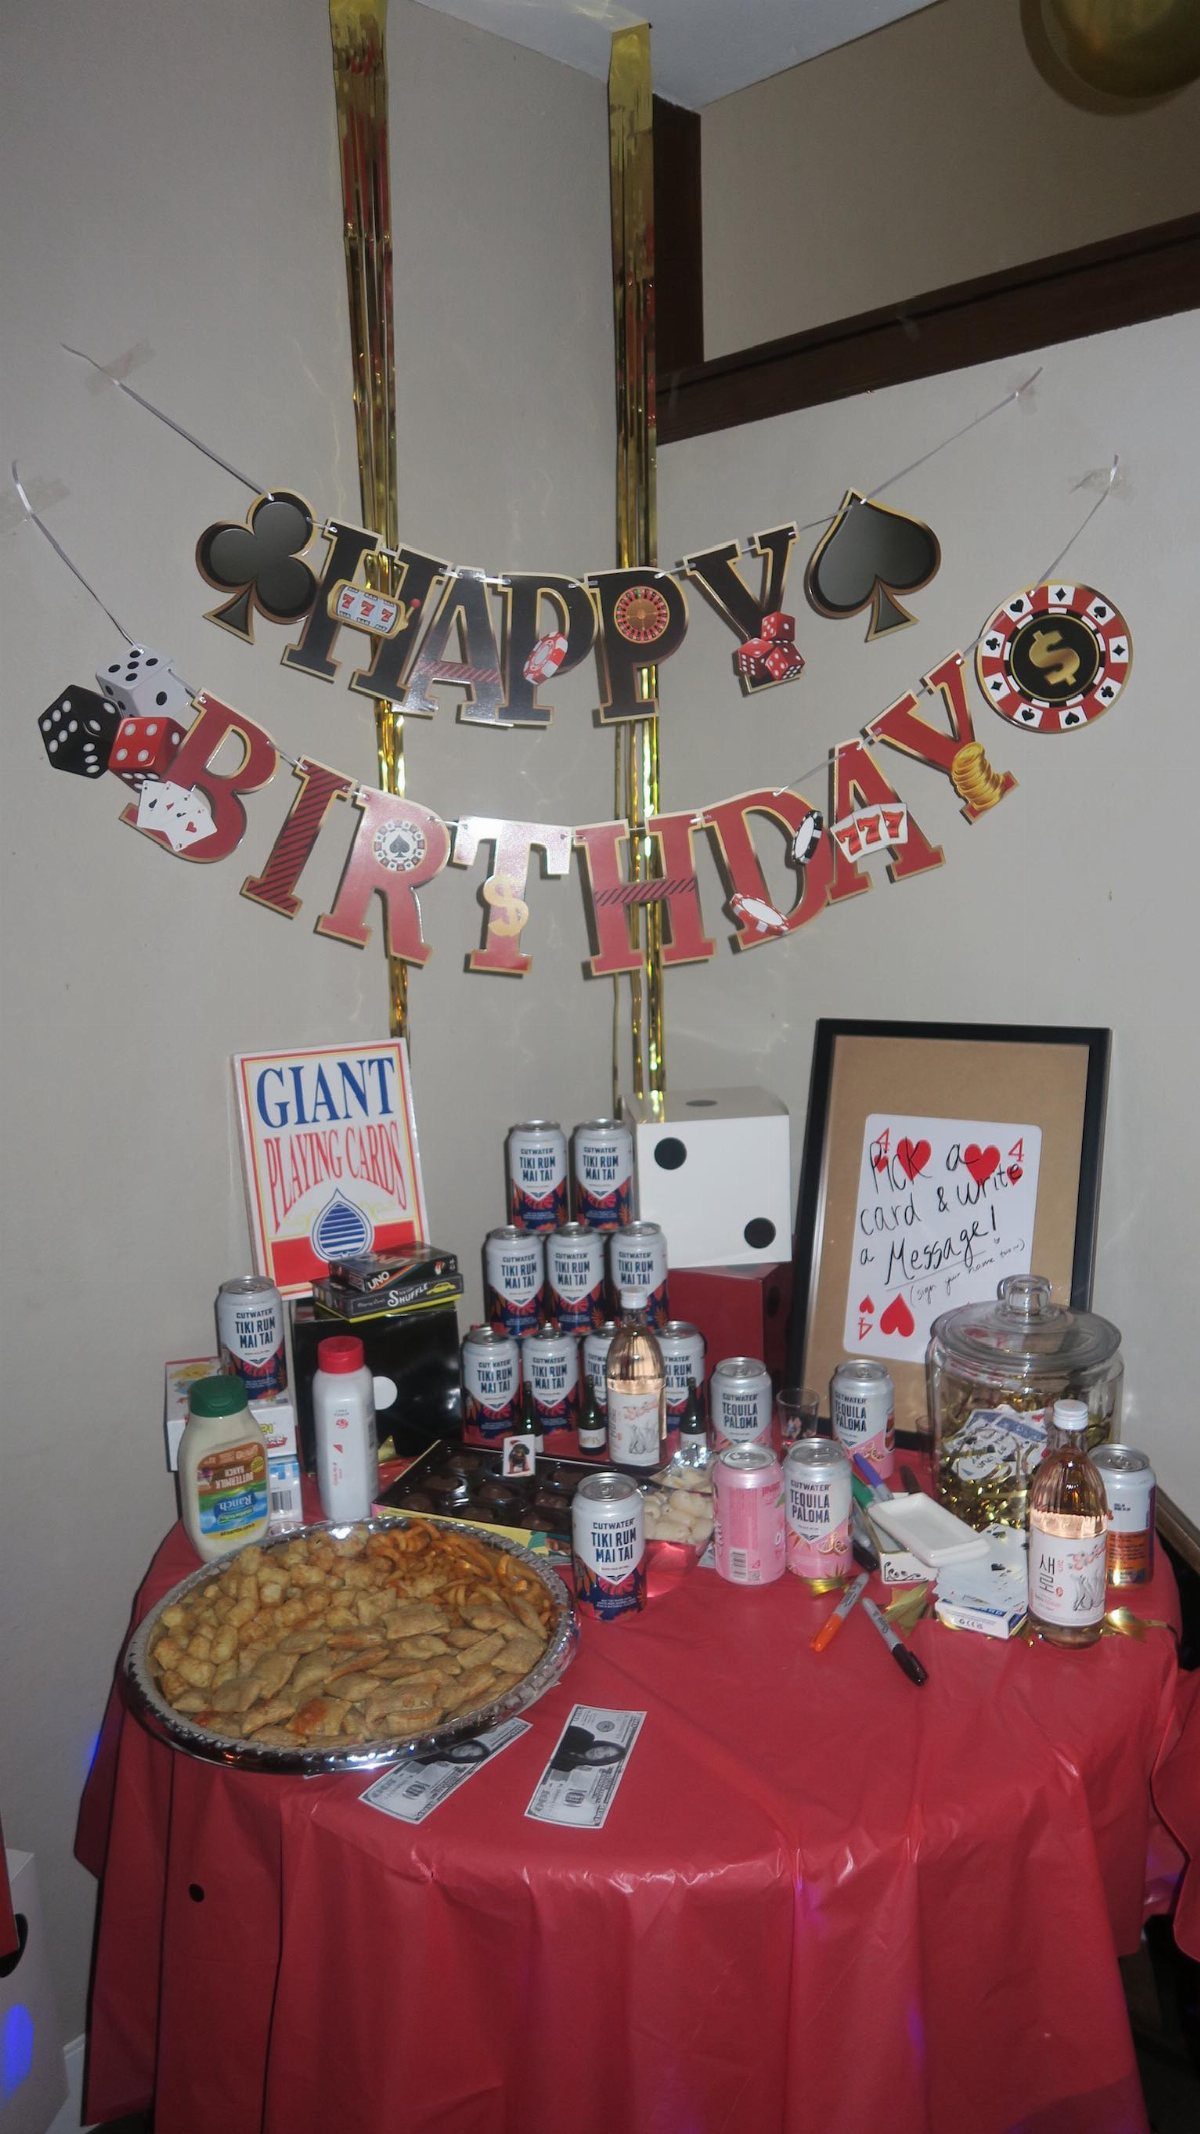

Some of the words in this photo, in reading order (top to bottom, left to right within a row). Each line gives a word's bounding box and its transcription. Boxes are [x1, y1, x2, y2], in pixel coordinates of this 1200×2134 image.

[281, 521, 799, 729] HAPPY
[119, 650, 1020, 976] BIRTHDAY
[257, 1057, 395, 1129] GIANT
[519, 1157, 536, 1169] TIKI
[538, 1156, 556, 1168] RUM
[583, 1155, 598, 1167] TIKI
[600, 1155, 619, 1167] RUM
[264, 1129, 343, 1234] PLAYING
[345, 1121, 407, 1210] CARDS
[522, 1170, 538, 1181] MAI
[540, 1169, 552, 1181] TAI
[585, 1168, 600, 1180] MAI
[602, 1168, 615, 1180] TAI
[860, 1193, 921, 1236] card
[937, 1187, 949, 1213] &
[502, 1254, 536, 1262] CUTWATER
[618, 1251, 651, 1259] CUTWATER
[860, 1248, 875, 1265] a
[501, 1264, 518, 1276] TIKI
[520, 1262, 537, 1276] RUM
[555, 1260, 570, 1273] TIKI
[572, 1260, 590, 1273] RUM
[618, 1259, 634, 1272] TIKI
[635, 1259, 654, 1272] RUM
[367, 1271, 390, 1290] UNO
[505, 1277, 521, 1289] MAI
[523, 1276, 535, 1287] TAI
[558, 1274, 572, 1286] MAI
[574, 1274, 587, 1286] TAI
[620, 1274, 635, 1285] MAI
[638, 1273, 650, 1285] TAI
[236, 1308, 273, 1319] CUTWATER
[235, 1320, 254, 1334] TIKI
[257, 1316, 275, 1332] RUM
[240, 1334, 257, 1349] MAI
[260, 1331, 273, 1345] TAI
[477, 1370, 494, 1381] TIKI
[496, 1367, 512, 1381] RUM
[531, 1365, 547, 1377] TIKI
[549, 1364, 567, 1377] RUM
[674, 1364, 691, 1376] RUM
[481, 1382, 496, 1393] MAI
[499, 1381, 510, 1393] TAI
[535, 1378, 549, 1389] MAI
[552, 1377, 564, 1389] TAI
[722, 1393, 758, 1401] CUTWATER
[722, 1402, 758, 1416] TEQUILA
[835, 1400, 866, 1418] TEQUILA
[724, 1415, 758, 1428] PALOMA
[836, 1414, 867, 1432] PALOMA
[215, 1472, 254, 1489] BUTTERMILK
[791, 1480, 831, 1491] CUTWATER
[220, 1495, 251, 1511] Ranch
[790, 1489, 830, 1508] TEQUILA
[792, 1505, 830, 1523] PALOMA
[592, 1518, 635, 1530] CUTWATER
[591, 1532, 613, 1547] TIKI
[616, 1528, 637, 1547] RUM
[595, 1549, 616, 1562] MAI
[618, 1544, 633, 1562] TAI
